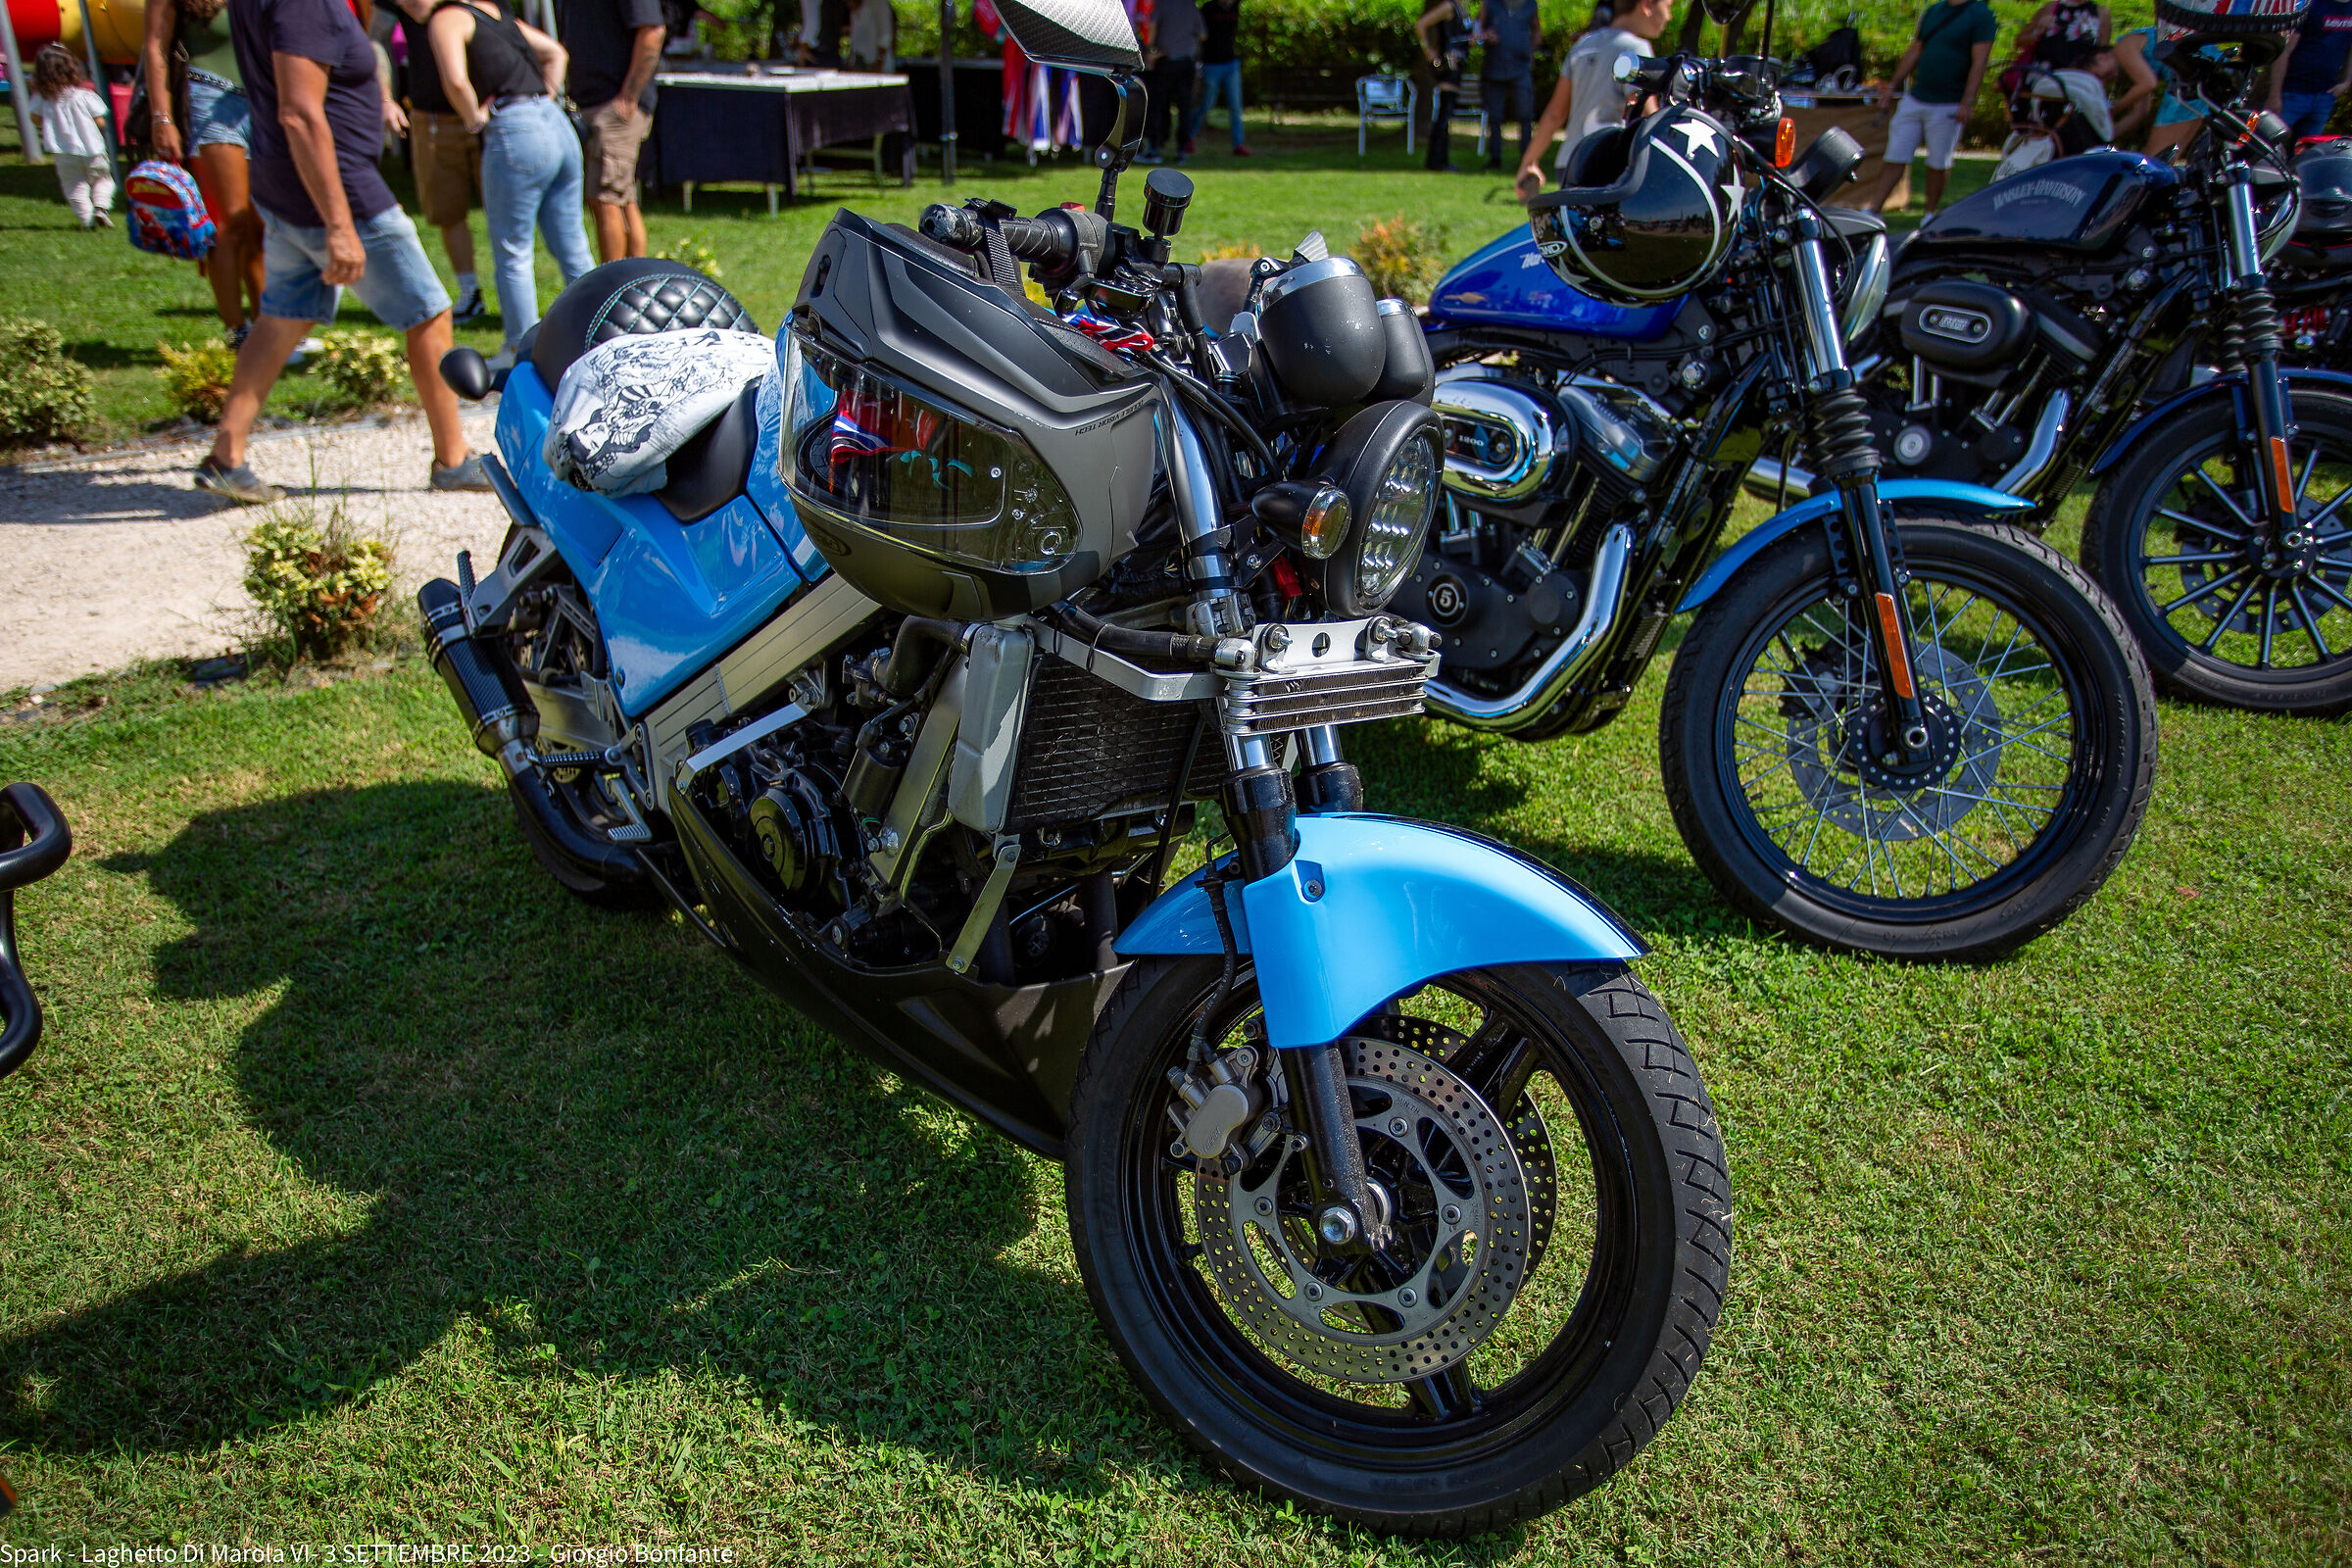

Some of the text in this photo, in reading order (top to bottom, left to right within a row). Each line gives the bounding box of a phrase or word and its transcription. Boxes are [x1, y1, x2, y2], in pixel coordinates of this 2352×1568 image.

[1099, 415, 1120, 428] VISOR
[1074, 424, 1097, 436] TECH
[1458, 434, 1485, 448] 1200
[1440, 589, 1452, 608] 5
